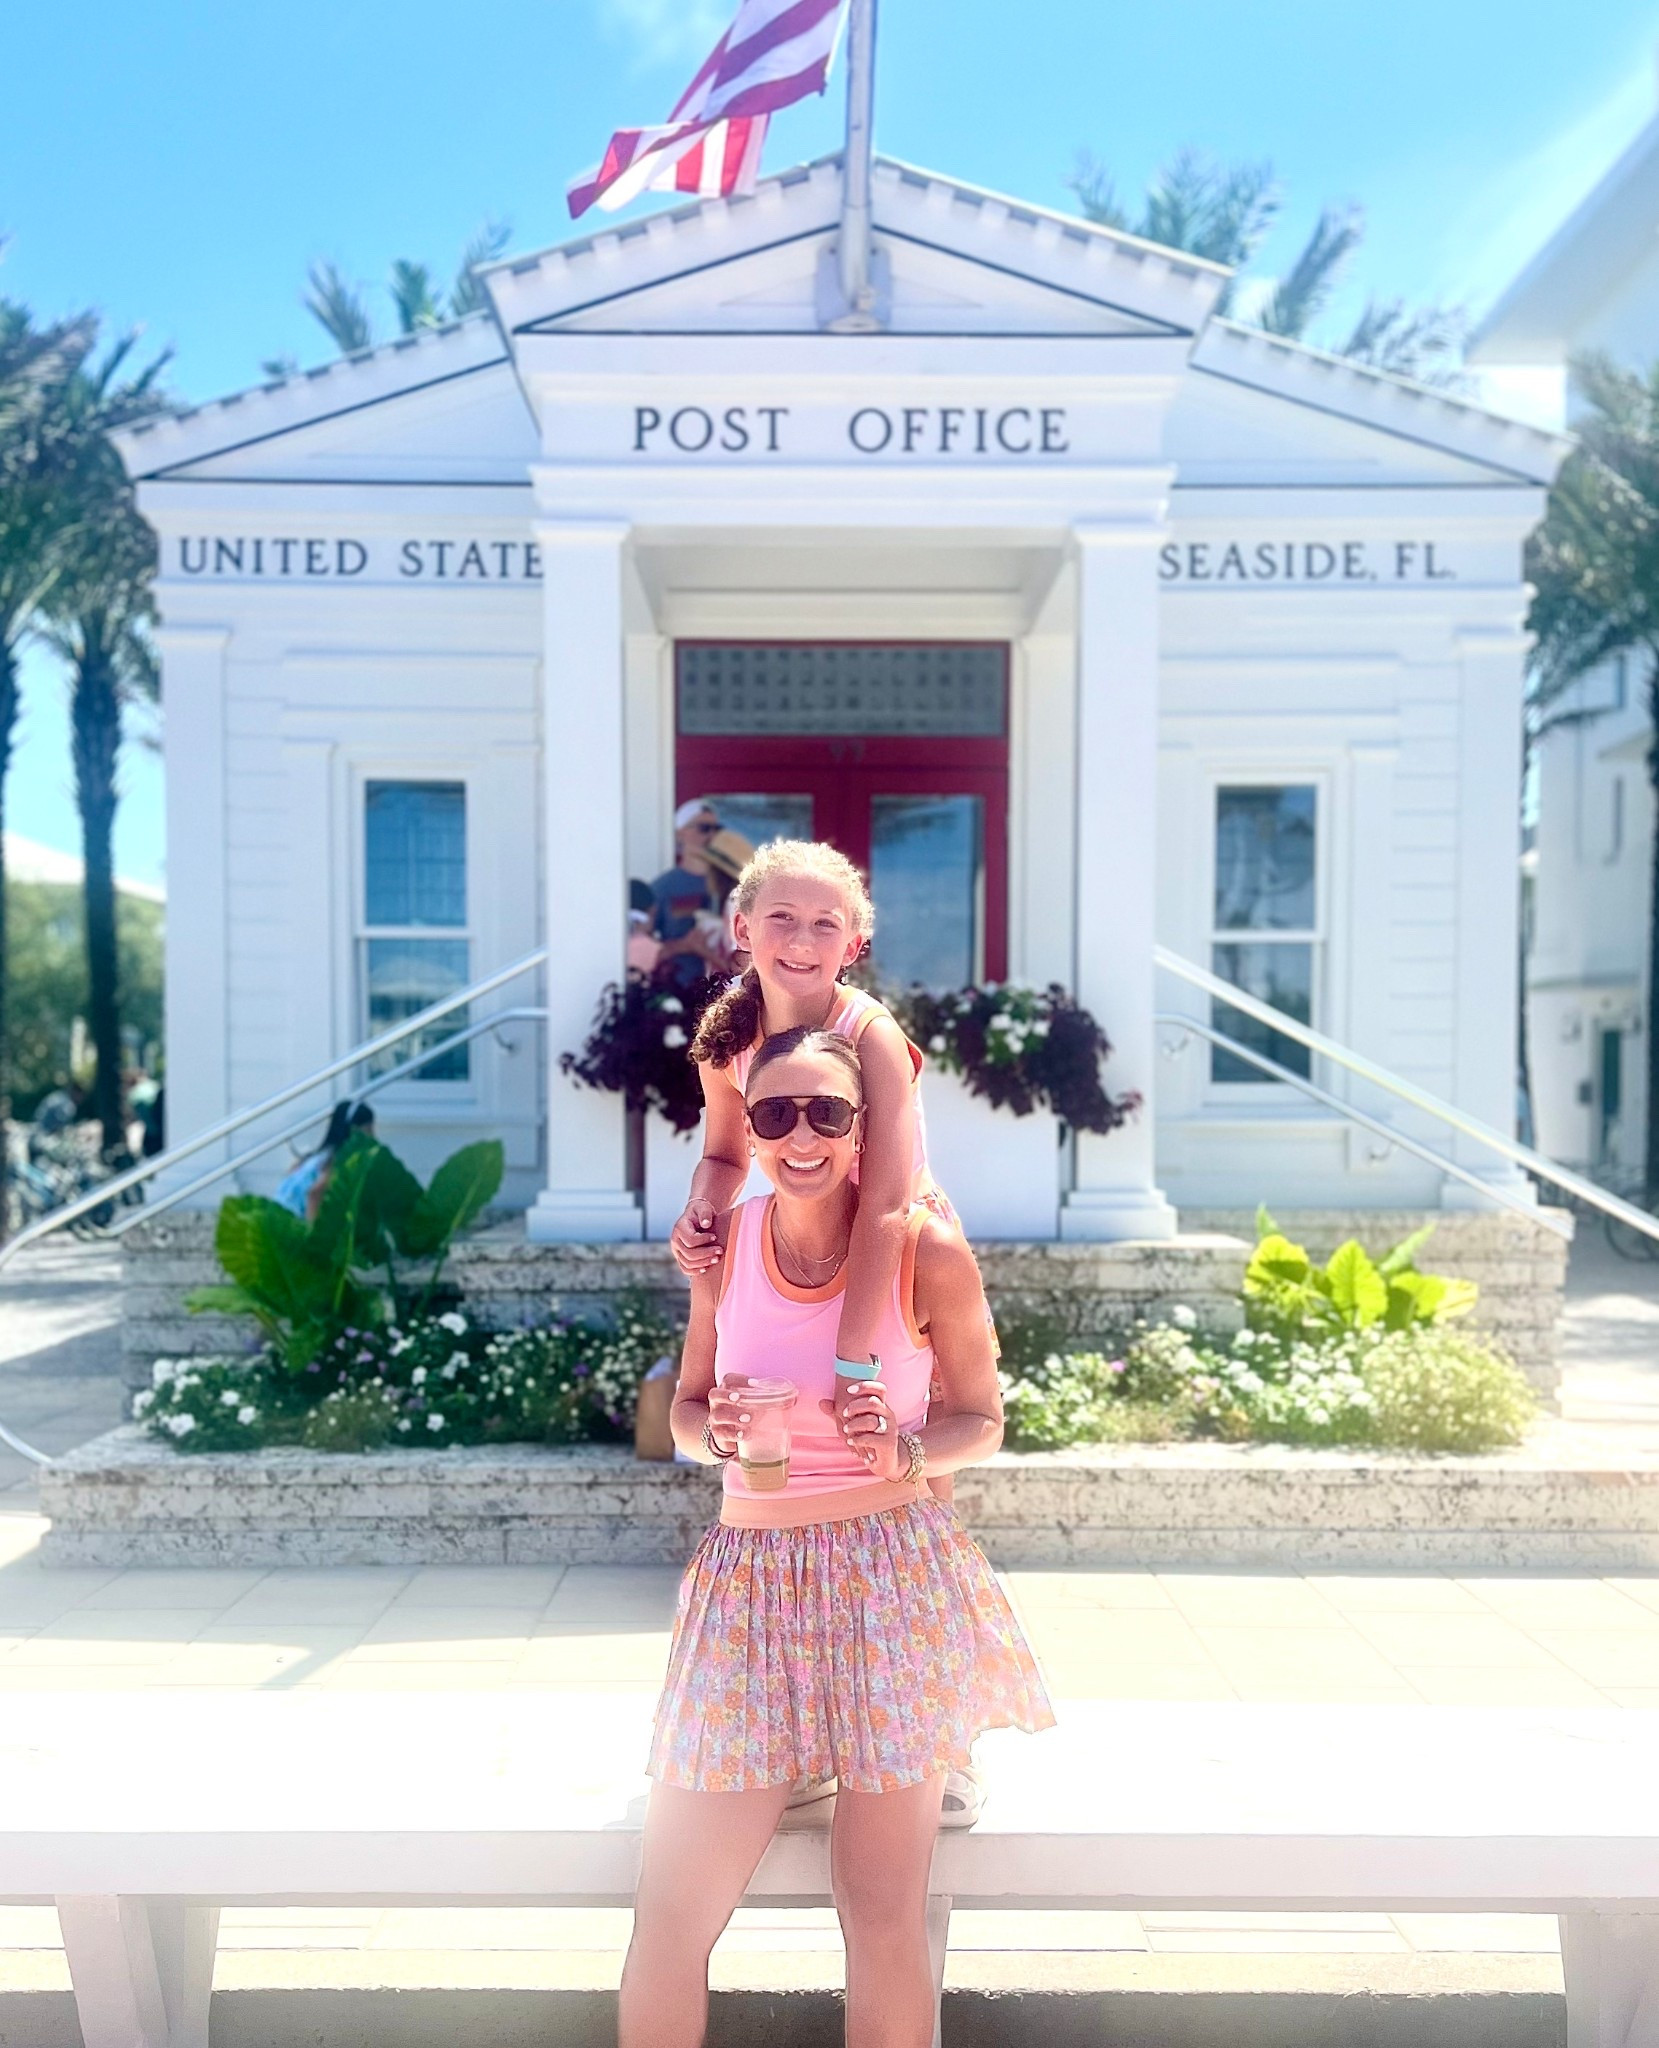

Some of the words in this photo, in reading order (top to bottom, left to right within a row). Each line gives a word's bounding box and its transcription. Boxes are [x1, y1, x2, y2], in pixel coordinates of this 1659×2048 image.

[632, 405, 790, 453] POST
[846, 406, 1070, 454] OFFICE
[178, 535, 369, 576] UNITED
[1157, 541, 1378, 582] SEASIDE,
